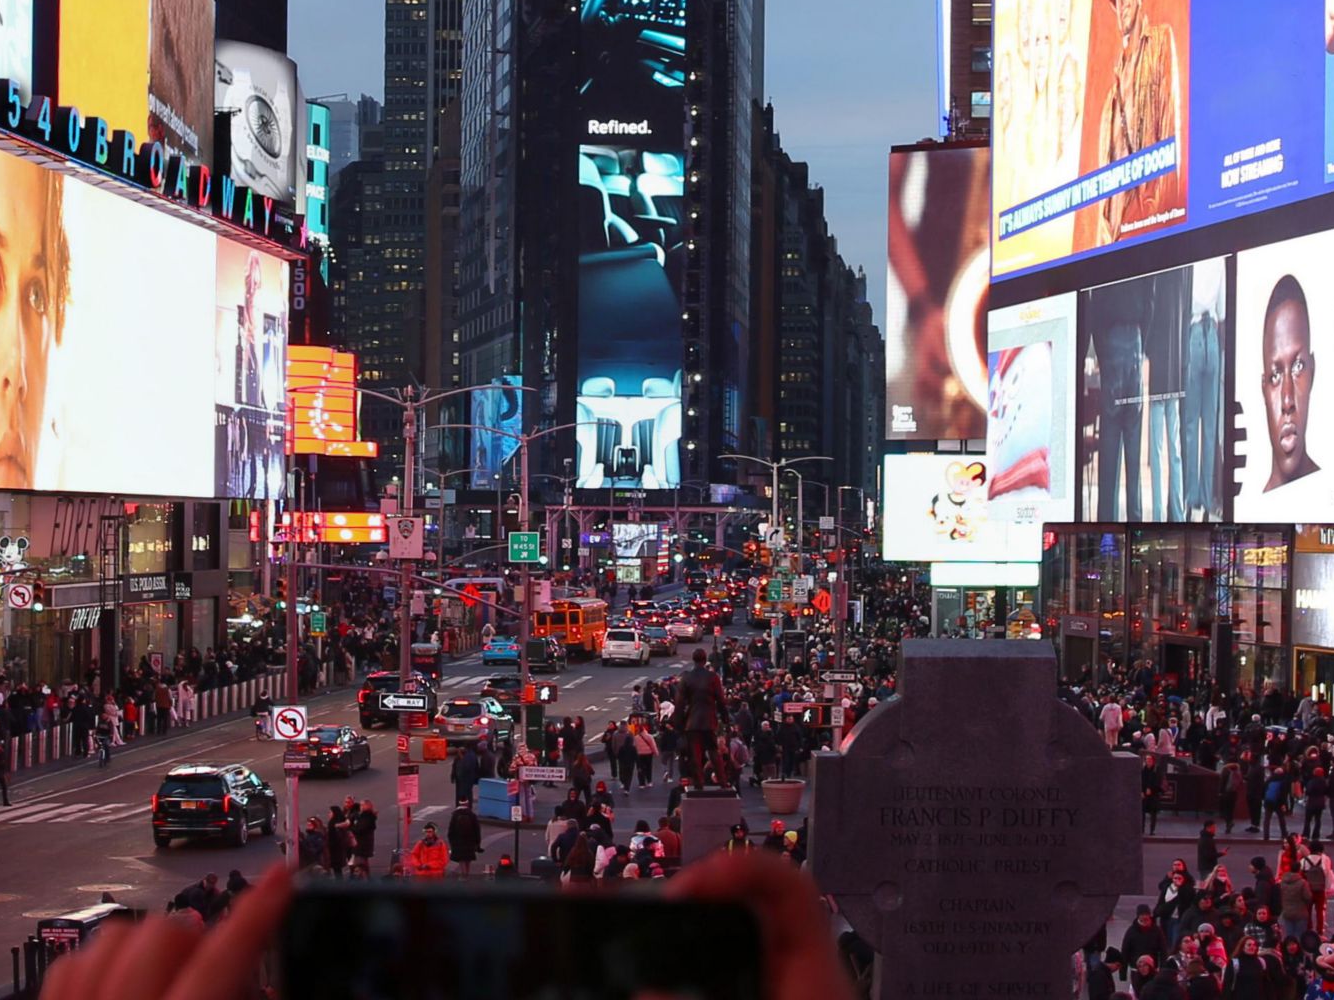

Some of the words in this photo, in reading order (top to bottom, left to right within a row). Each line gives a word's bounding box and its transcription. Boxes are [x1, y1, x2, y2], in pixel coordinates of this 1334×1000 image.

[588, 119, 652, 134] Refined.
[94, 118, 273, 236] BROADWAY
[1220, 167, 1240, 189] NOW
[1240, 154, 1283, 183] STREAMING
[999, 212, 1014, 237] IT'S
[1013, 200, 1044, 233] ALWAYS
[1043, 186, 1072, 221] SUNNY
[1072, 182, 1082, 209] IN
[1082, 173, 1099, 206] THE
[1099, 158, 1131, 200] TEMPLE
[1131, 153, 1144, 182] OF
[1144, 142, 1175, 177] DOOM
[139, 578, 153, 592] POLO
[795, 588, 806, 596] 25
[69, 608, 101, 631] FOREVER
[406, 699, 422, 707] WAY
[893, 786, 985, 801] LIEUTENANT
[989, 786, 1062, 801] COLONEL
[880, 806, 972, 827] FRANCIS
[1002, 807, 1079, 828] DUFFY
[891, 834, 919, 847] MAY
[978, 834, 1010, 847] JUNE
[904, 858, 986, 874] CATHOLIC
[994, 858, 1052, 874] PRIEST
[939, 897, 1016, 913] CHAPLAIN
[982, 920, 1052, 935] INFANTRY
[923, 941, 956, 955] OLD
[923, 982, 953, 995] LIFE
[959, 982, 980, 995] OF
[987, 982, 1051, 996] SERVICE
